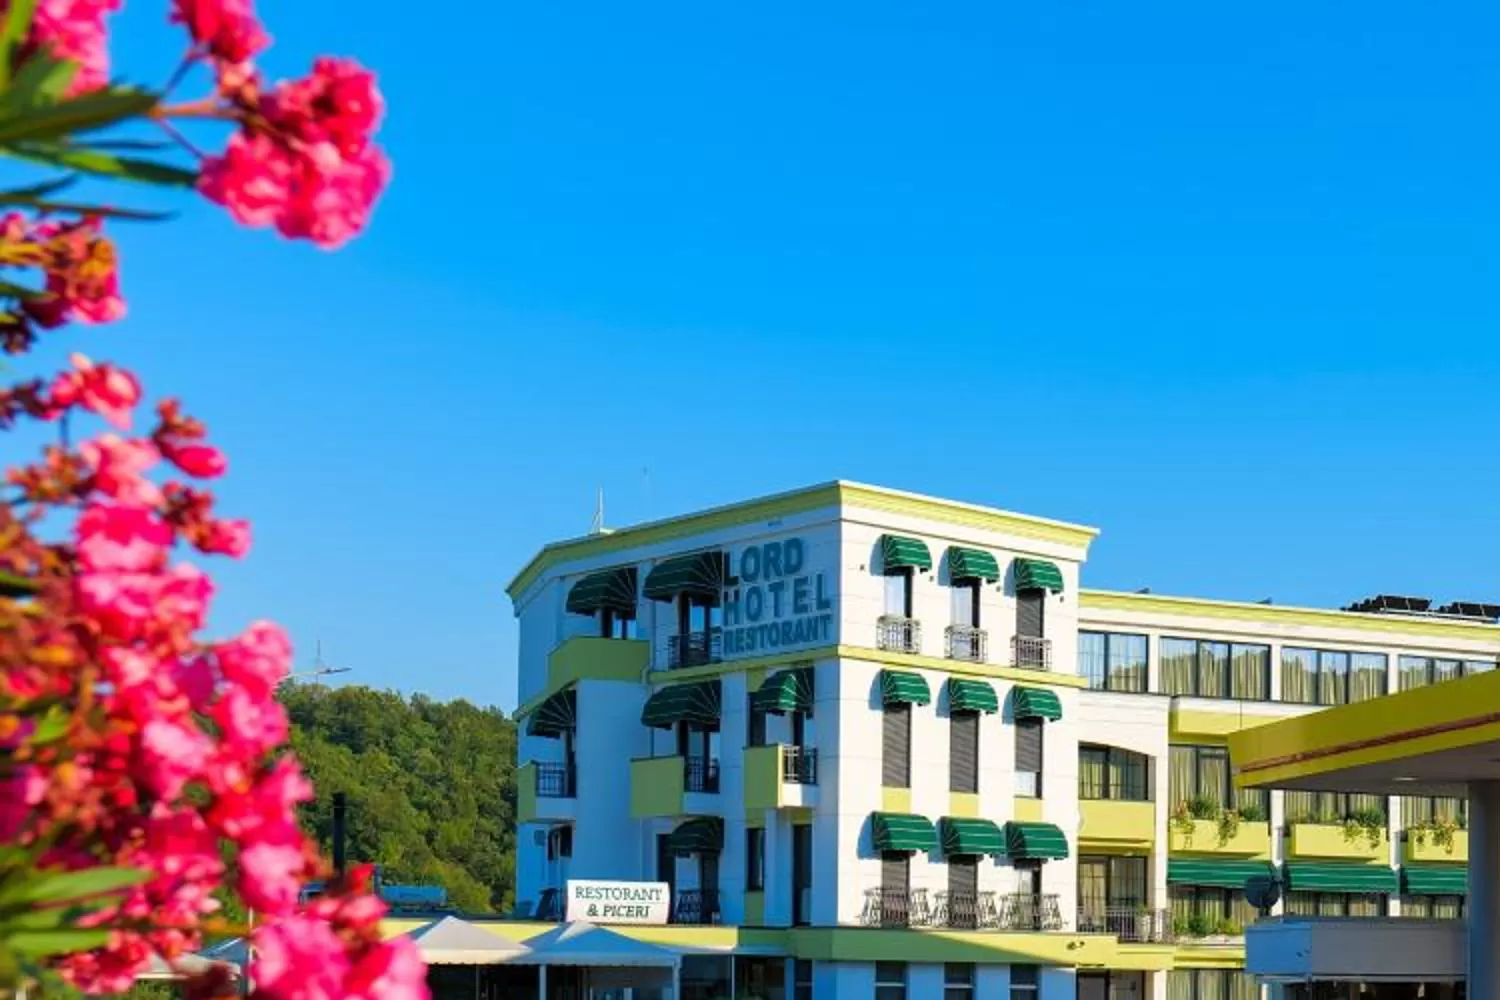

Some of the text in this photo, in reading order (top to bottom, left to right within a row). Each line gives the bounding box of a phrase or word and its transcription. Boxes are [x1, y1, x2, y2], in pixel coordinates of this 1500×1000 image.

[723, 537, 804, 587] LORD
[723, 572, 832, 626] HOTEL
[723, 614, 831, 657] RESTORANT
[575, 886, 663, 900] RESTORANT
[586, 904, 651, 918] & PICERI
